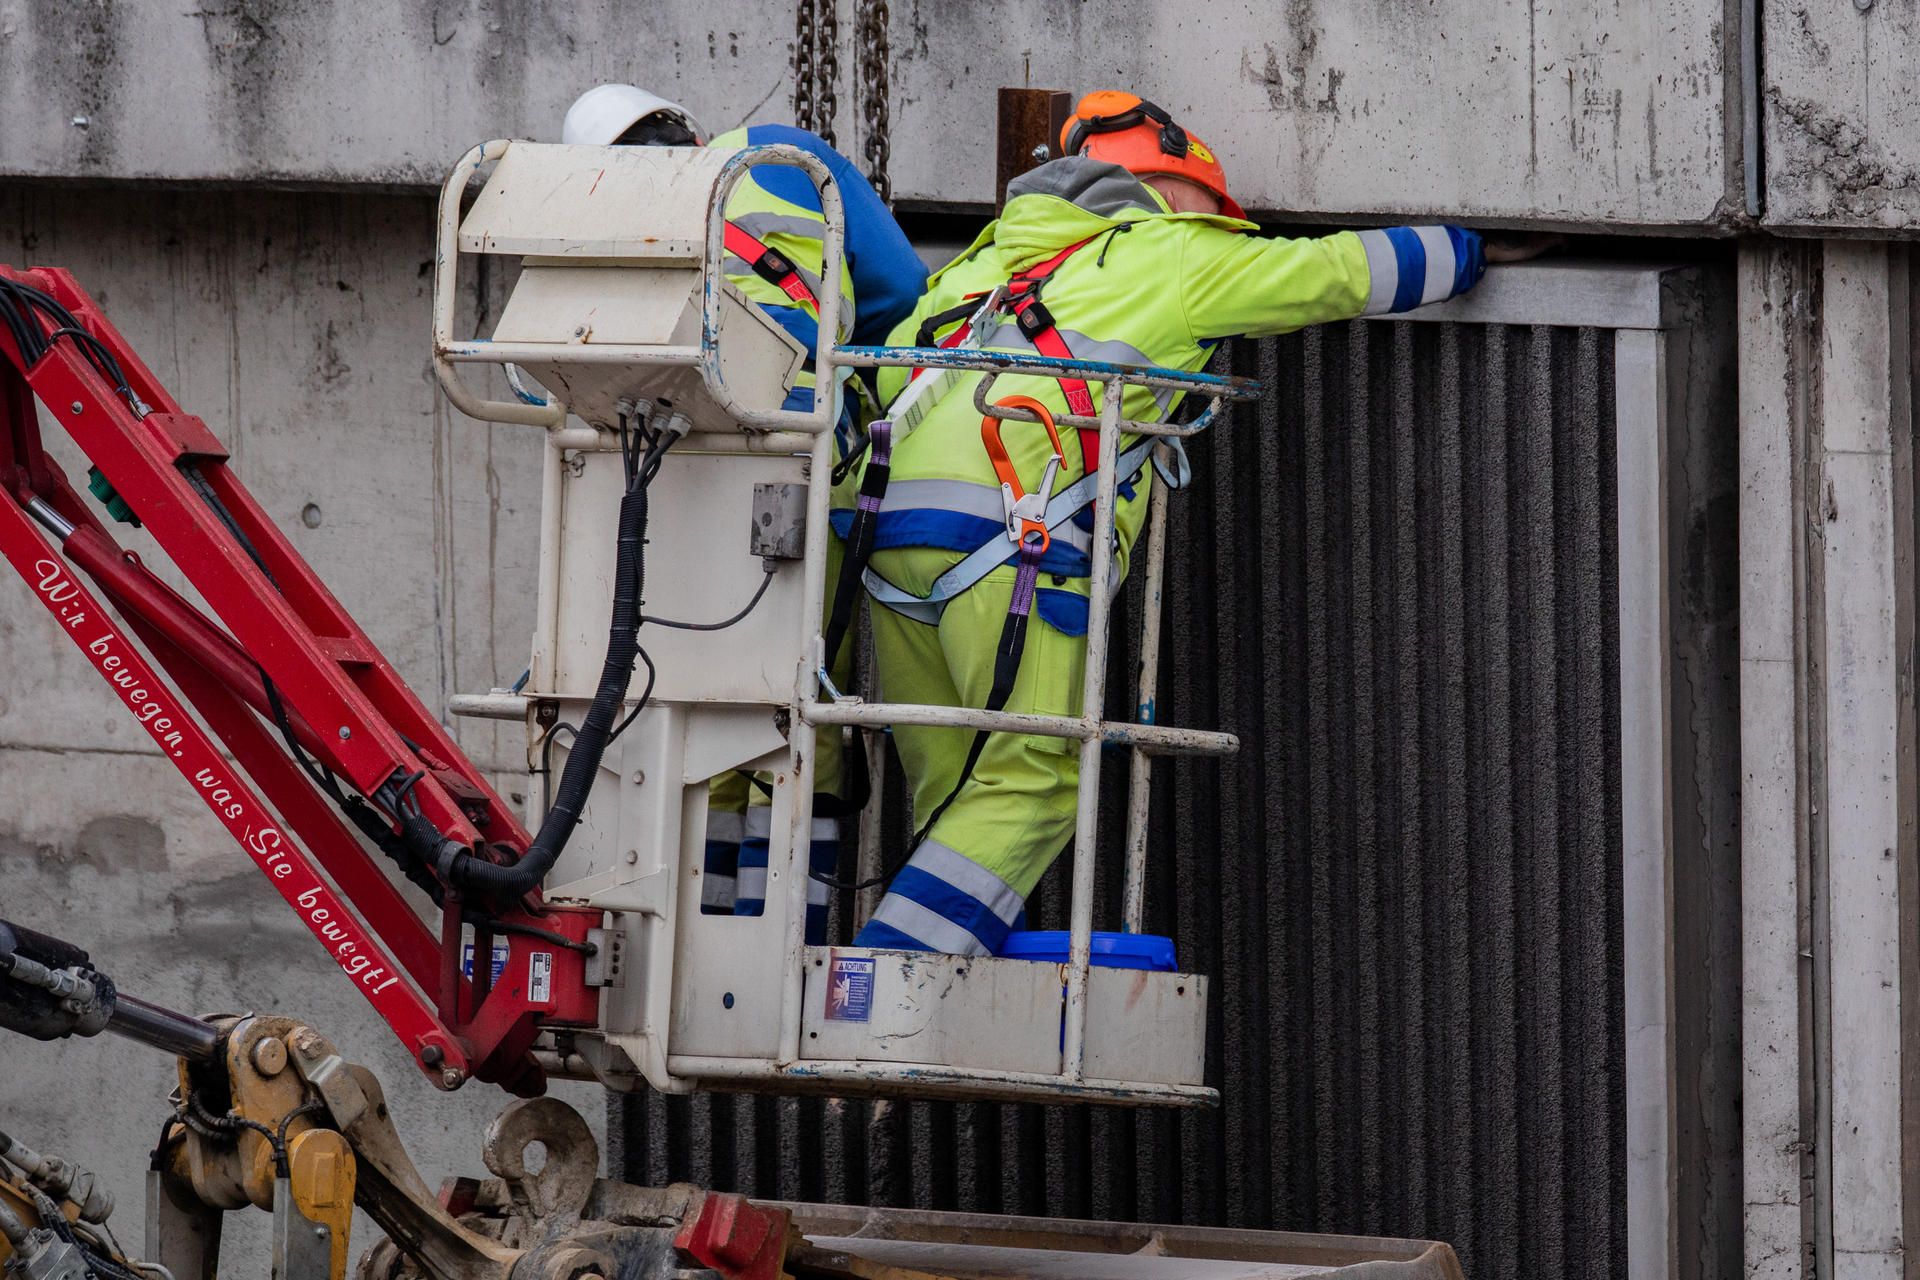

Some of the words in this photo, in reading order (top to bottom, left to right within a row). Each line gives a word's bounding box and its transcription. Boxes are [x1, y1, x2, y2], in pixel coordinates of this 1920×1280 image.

[35, 559, 86, 628] Wir
[89, 633, 183, 757] bewegen,
[196, 767, 243, 820] was
[247, 827, 292, 879] Sie
[297, 887, 398, 994] bewegt!
[844, 962, 868, 972] ACHTUNG
